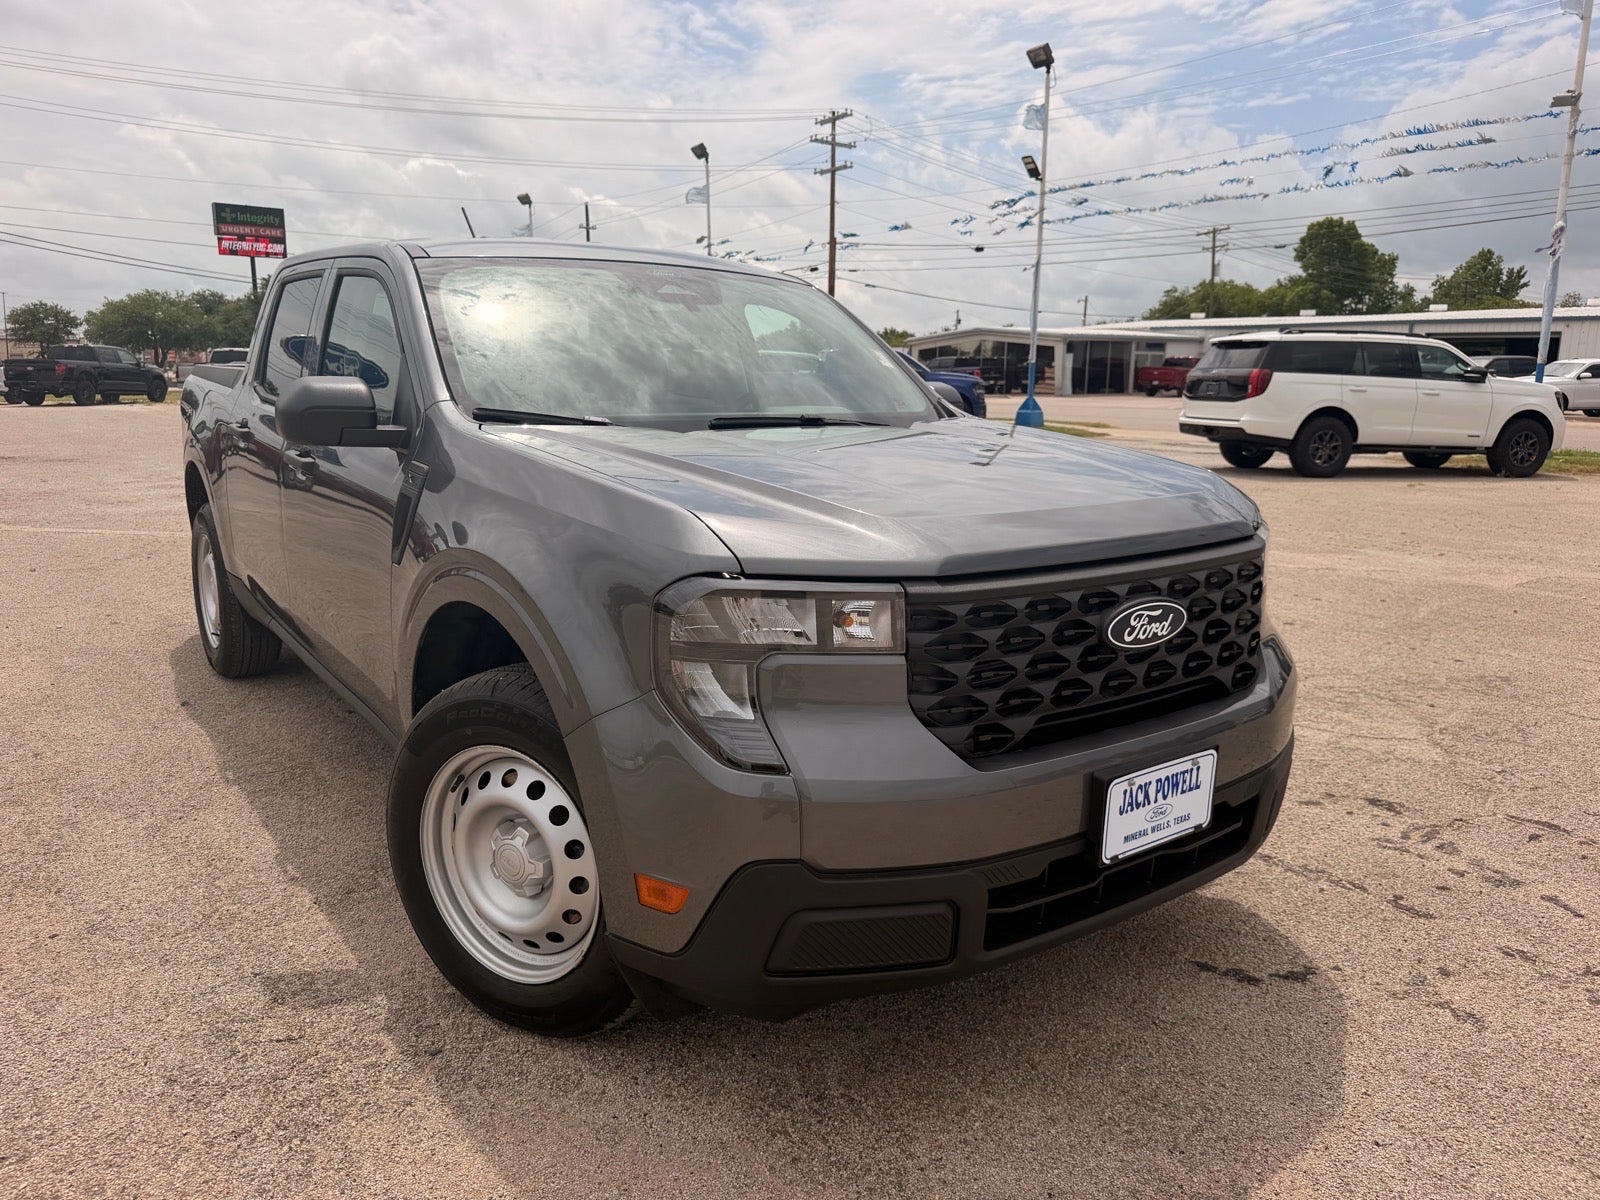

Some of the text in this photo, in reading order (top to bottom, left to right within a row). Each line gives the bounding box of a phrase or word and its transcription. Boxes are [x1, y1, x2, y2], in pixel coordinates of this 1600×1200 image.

[237, 212, 280, 226] Integrity
[222, 225, 281, 237] URGENT CARE
[1123, 608, 1174, 643] Ford
[1118, 765, 1202, 816] JACK POWELL
[1149, 806, 1168, 820] Ford
[1123, 813, 1191, 844] MINERAL WELLS, TEXAS
